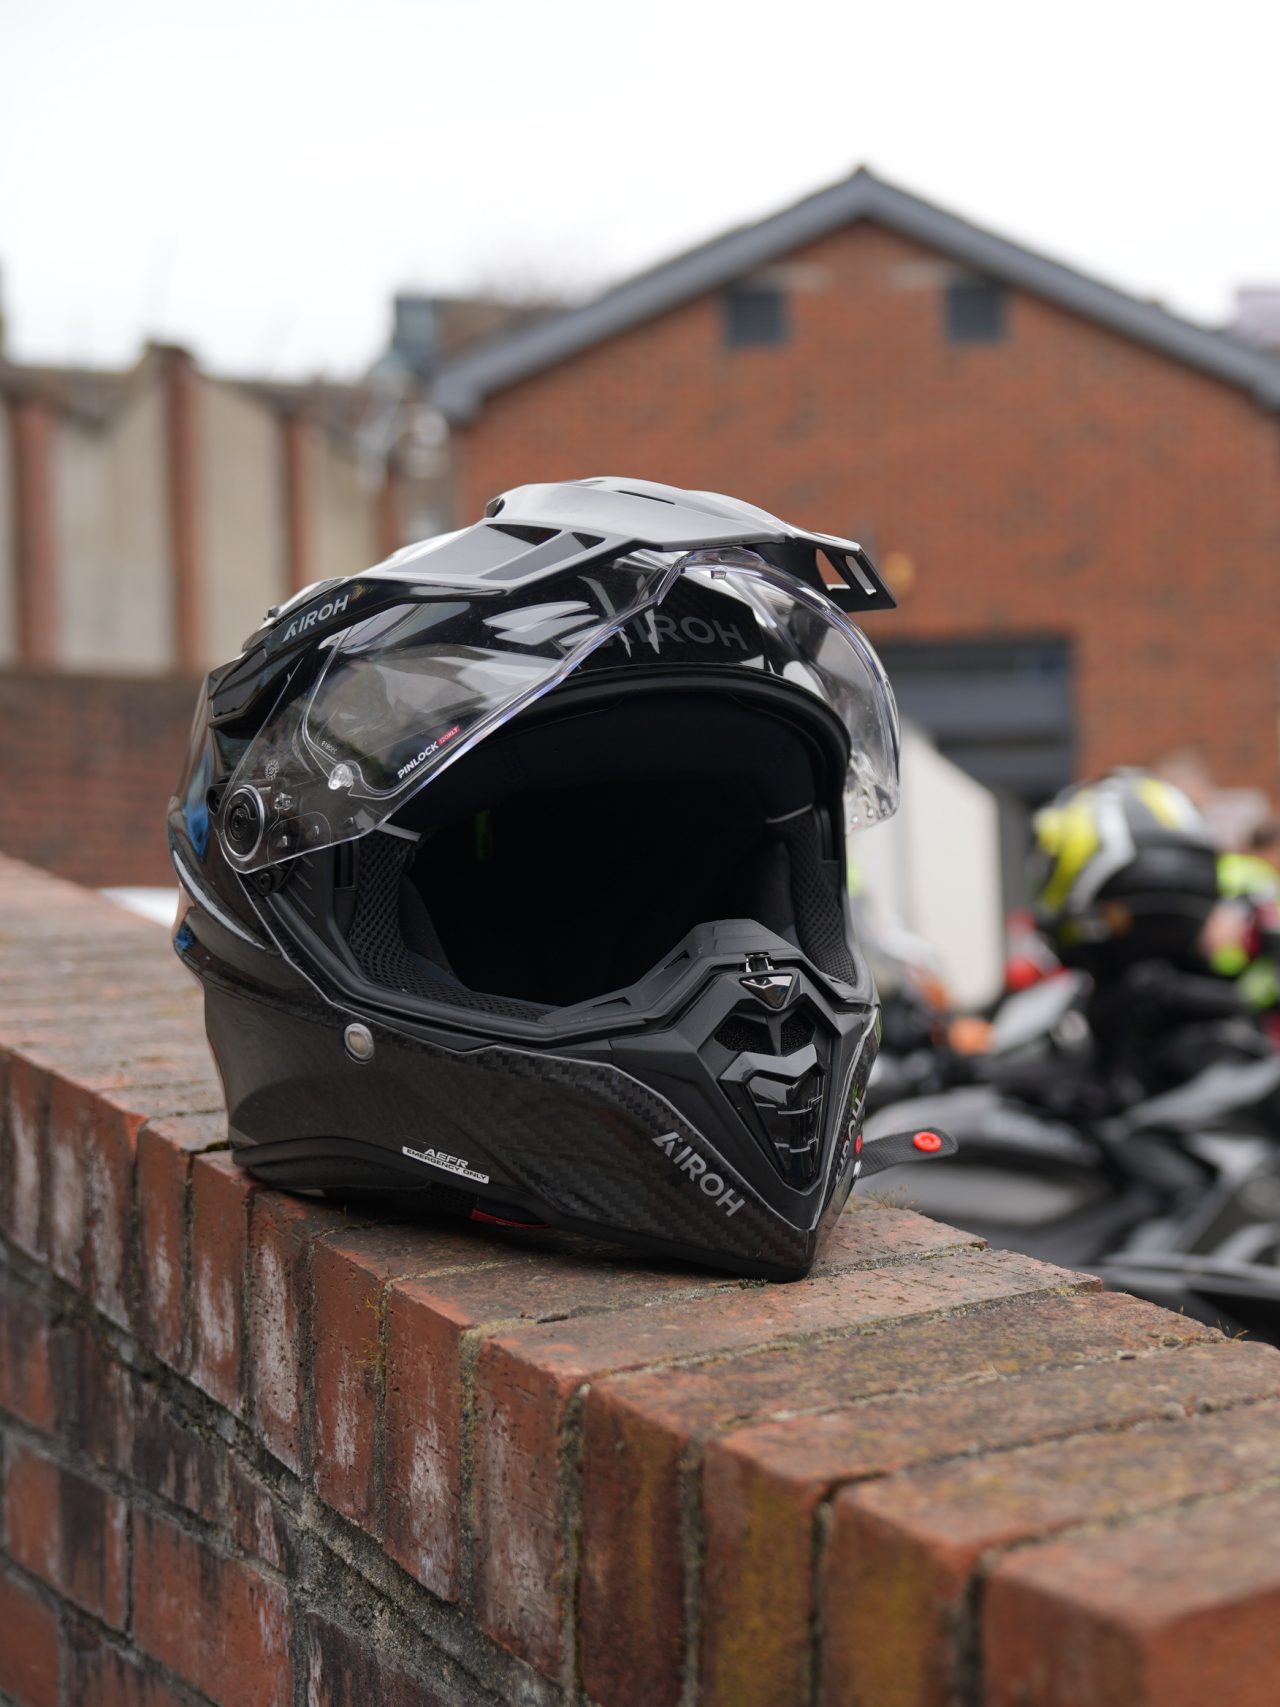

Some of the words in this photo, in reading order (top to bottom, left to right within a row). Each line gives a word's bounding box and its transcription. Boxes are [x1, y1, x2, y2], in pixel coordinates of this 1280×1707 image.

[282, 594, 349, 643] AIROH
[397, 740, 439, 779] PINLOCK
[406, 1148, 460, 1172] EMERGENCY
[462, 1169, 487, 1180] ONLY
[424, 1148, 469, 1168] AEFR
[651, 1131, 746, 1217] AIROH
